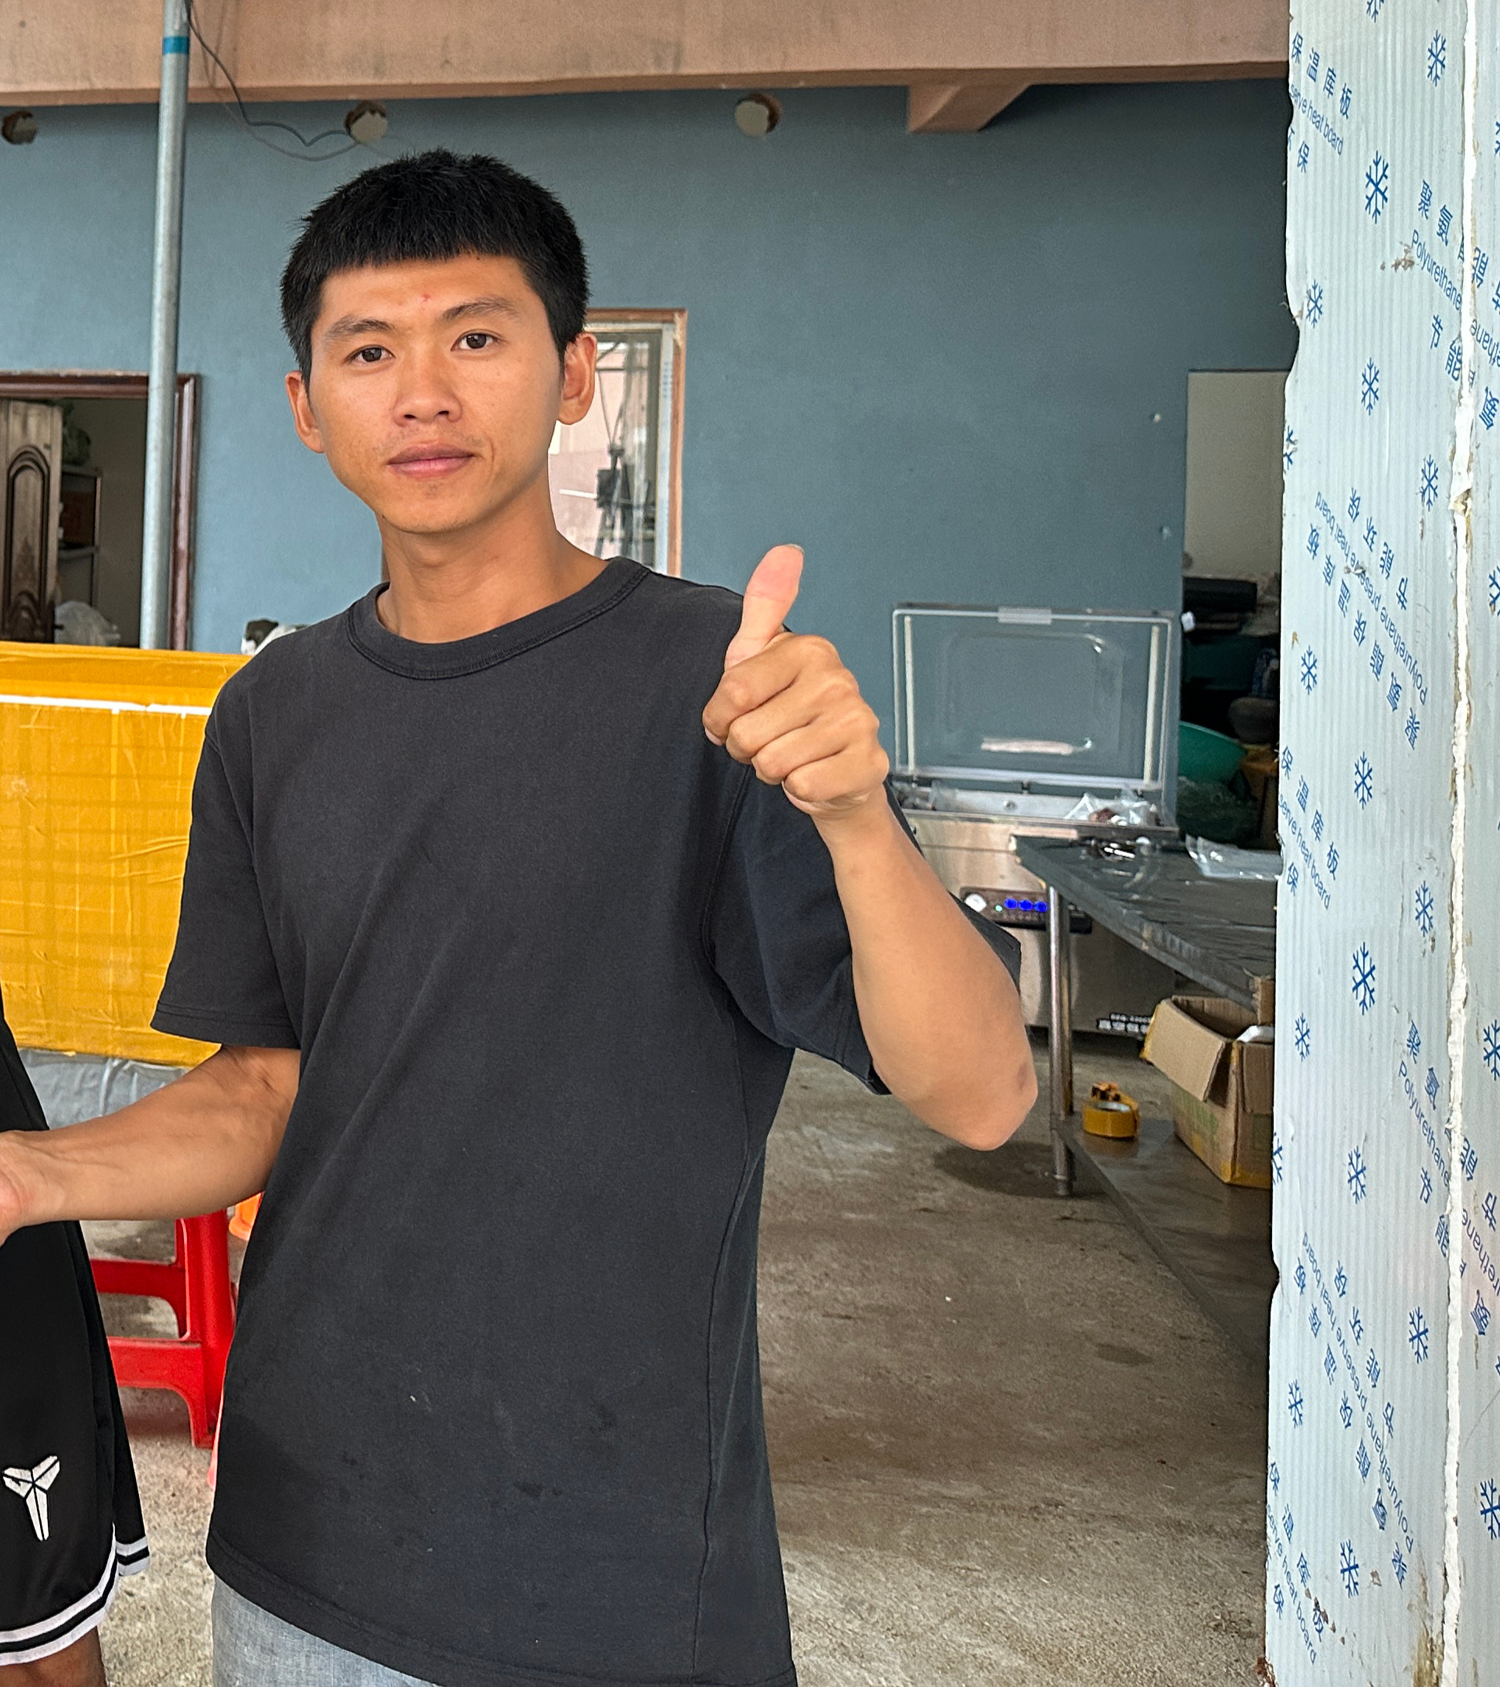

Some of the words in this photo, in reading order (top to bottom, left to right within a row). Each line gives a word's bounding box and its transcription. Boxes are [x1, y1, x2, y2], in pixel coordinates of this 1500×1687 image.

[1291, 32, 1353, 120] 保温库板
[1308, 100, 1325, 133] heat
[1324, 119, 1344, 155] board
[1412, 229, 1463, 310] Polyurethane
[1348, 487, 1409, 610] 节能环保
[1306, 523, 1421, 750] 聚氨酯保温库板
[1380, 607, 1428, 705] Polyurethane
[1281, 746, 1339, 880] 保温库板
[1296, 827, 1312, 868] heat
[1310, 859, 1331, 910] board
[1399, 1061, 1450, 1188] Polyurethane
[1303, 1232, 1322, 1288] board
[1334, 1260, 1394, 1438] 节能环保
[1336, 1327, 1368, 1411] preserve
[1294, 1257, 1408, 1589] 聚氨酯保温库板
[1366, 1412, 1414, 1553] Polyurethane
[1282, 1555, 1298, 1603] heat
[1296, 1601, 1317, 1665] board
